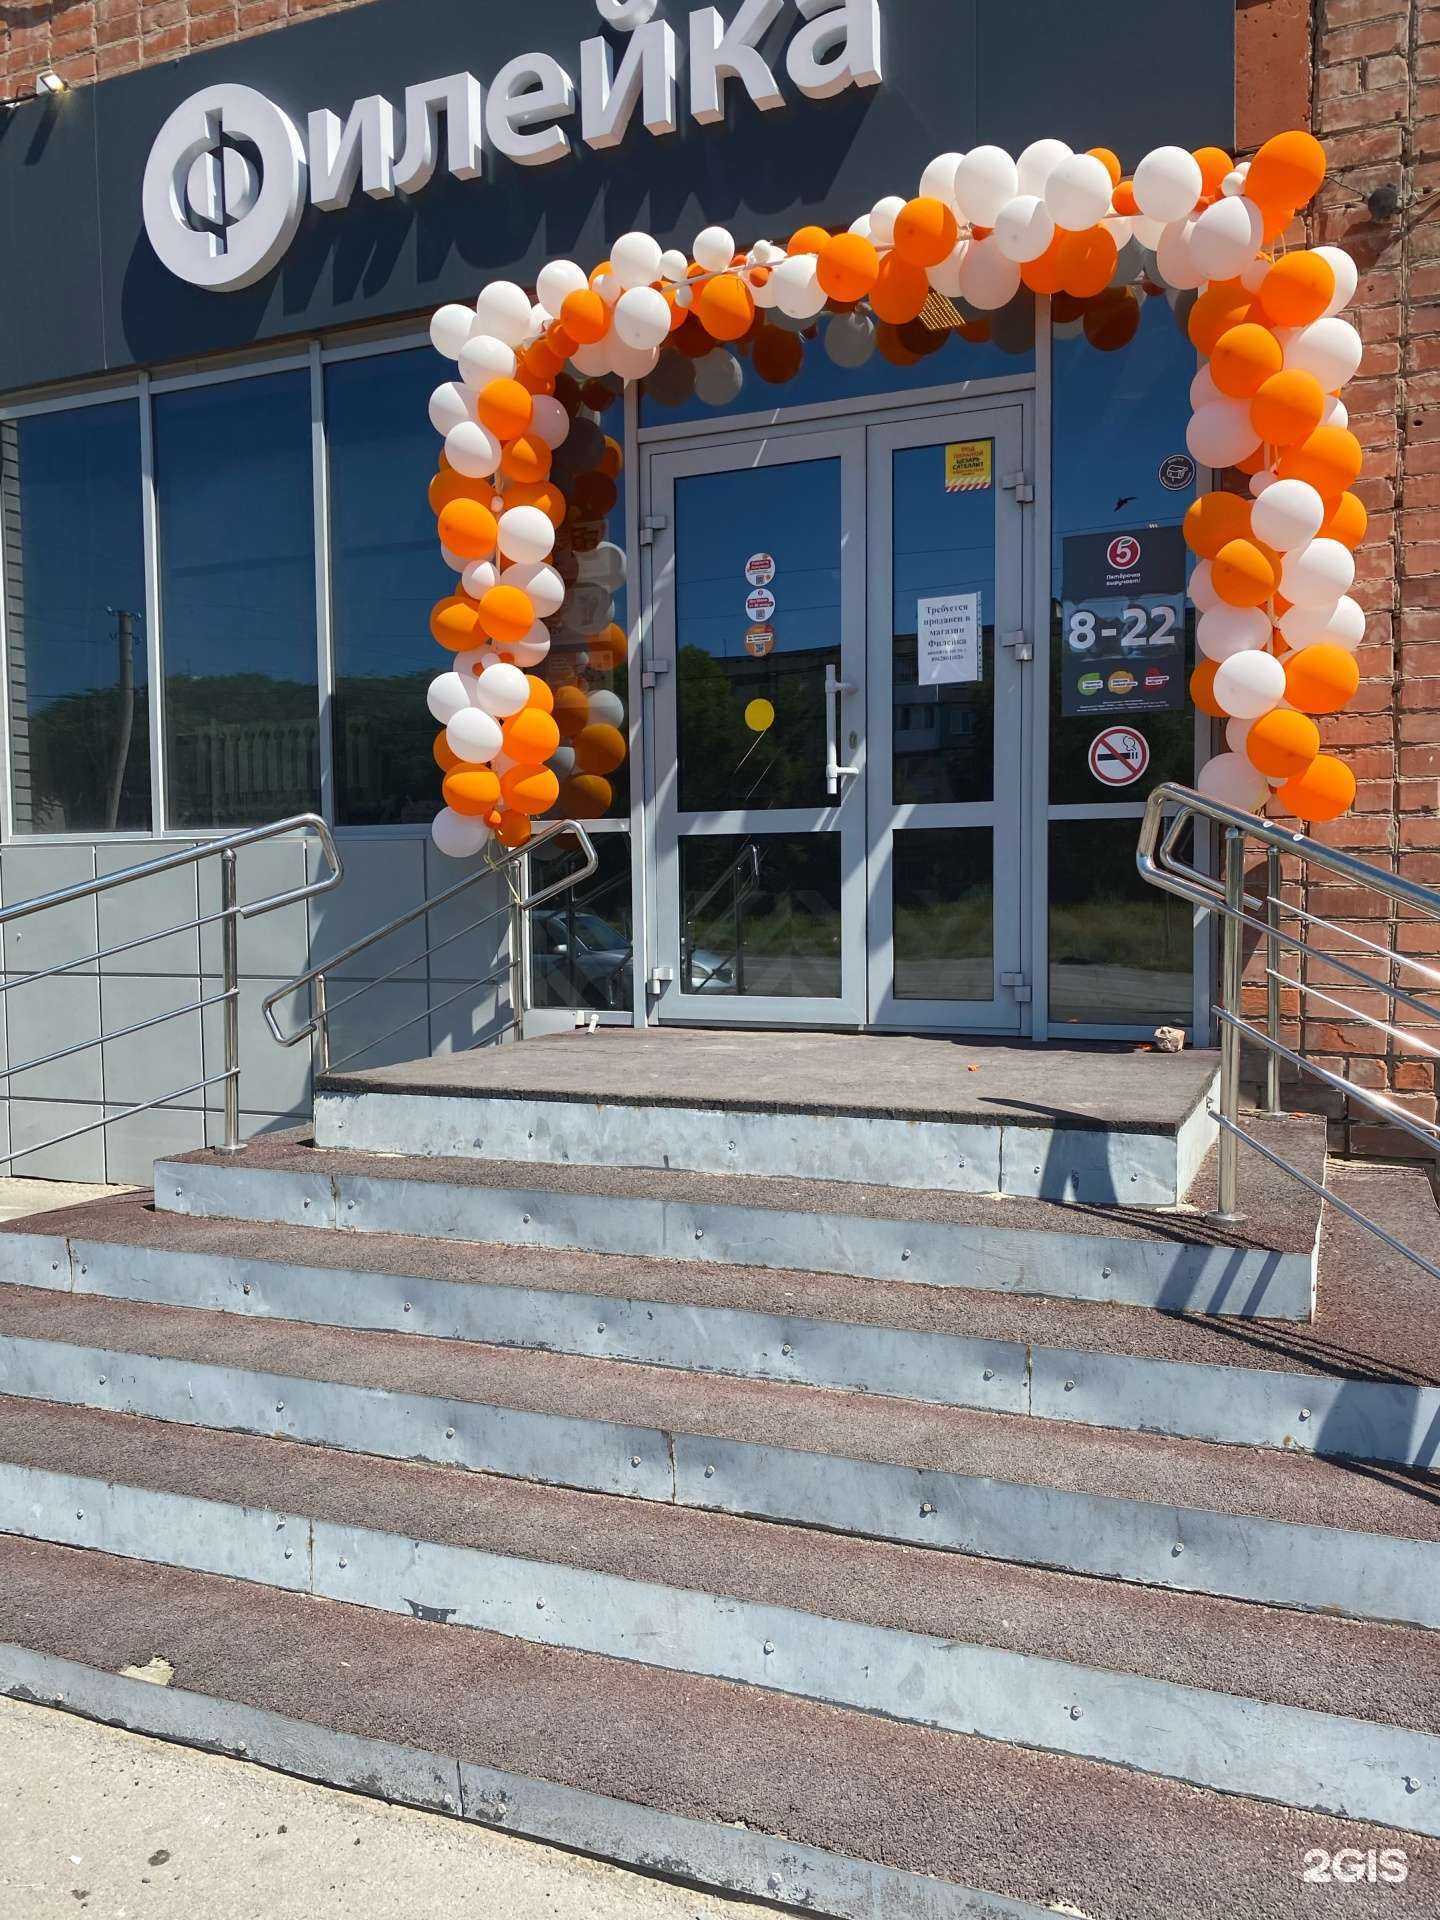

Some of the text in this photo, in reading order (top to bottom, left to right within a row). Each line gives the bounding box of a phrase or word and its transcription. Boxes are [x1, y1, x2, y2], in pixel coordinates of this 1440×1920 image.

[142, 0, 883, 293] Филейка
[926, 604, 968, 615] Требуется
[923, 616, 963, 627] продавец
[929, 627, 965, 636] магазин
